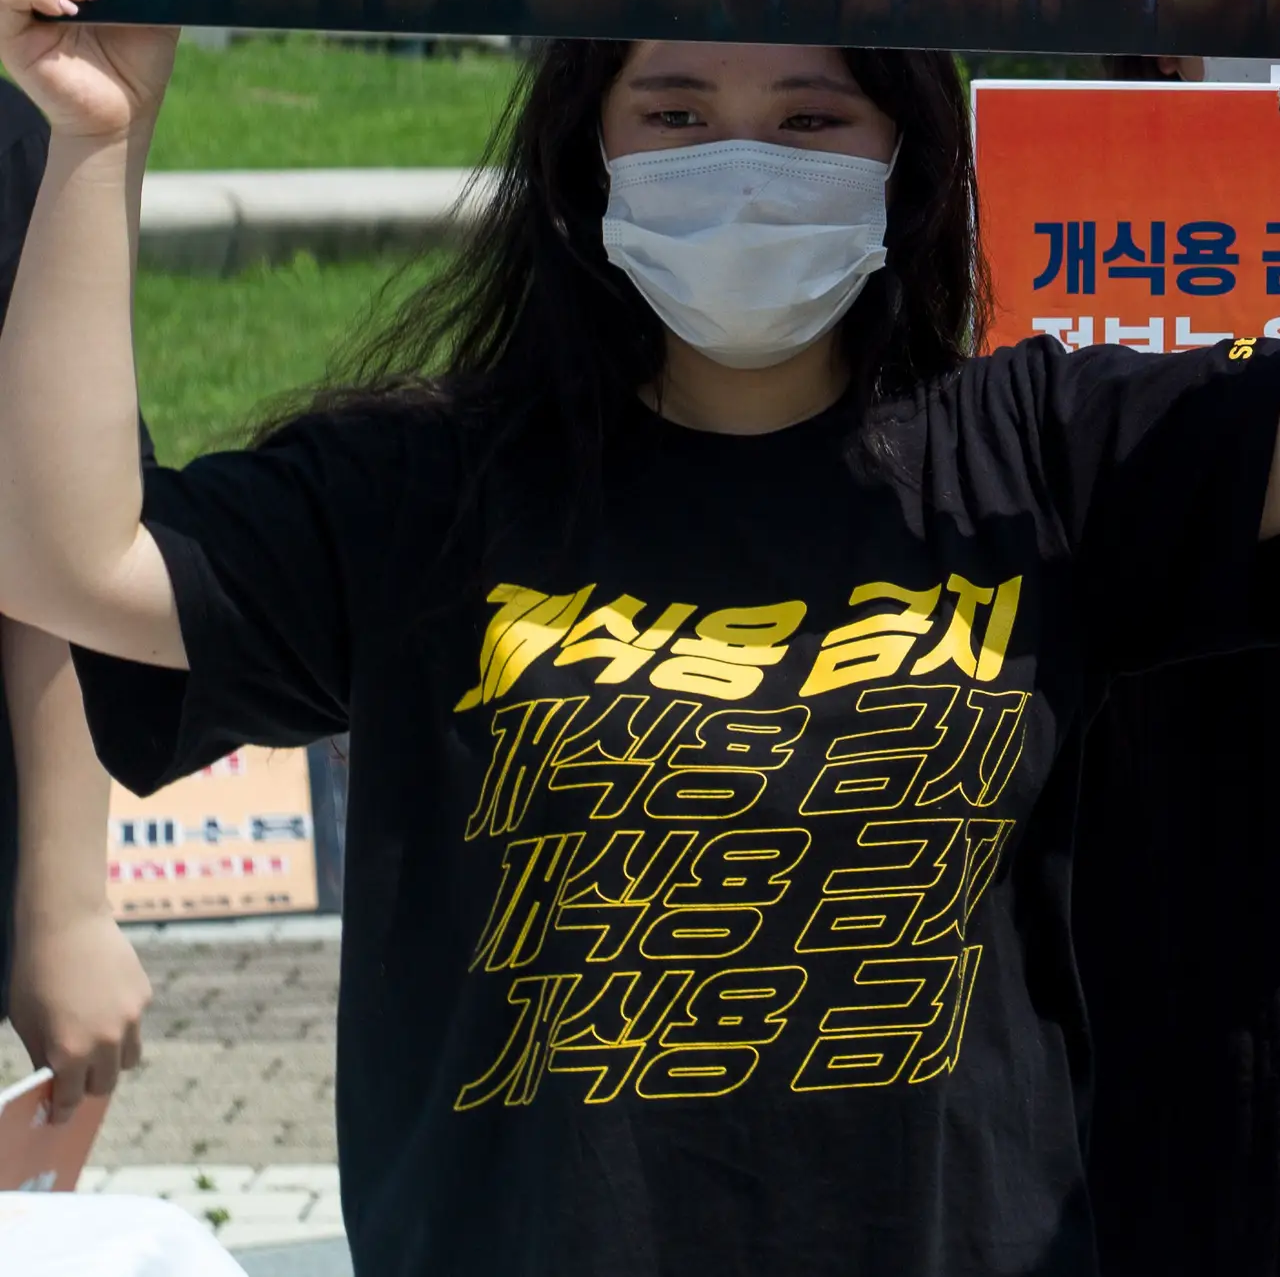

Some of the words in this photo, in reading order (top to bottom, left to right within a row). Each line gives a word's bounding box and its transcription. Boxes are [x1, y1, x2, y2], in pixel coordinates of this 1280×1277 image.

[1033, 221, 1239, 296] 개식용
[454, 582, 808, 713] 개식용
[797, 573, 1023, 698] 금지
[464, 694, 812, 841] 개식용
[797, 684, 1033, 816] 금지
[468, 826, 813, 973] 개식용
[453, 964, 809, 1111] 개식용
